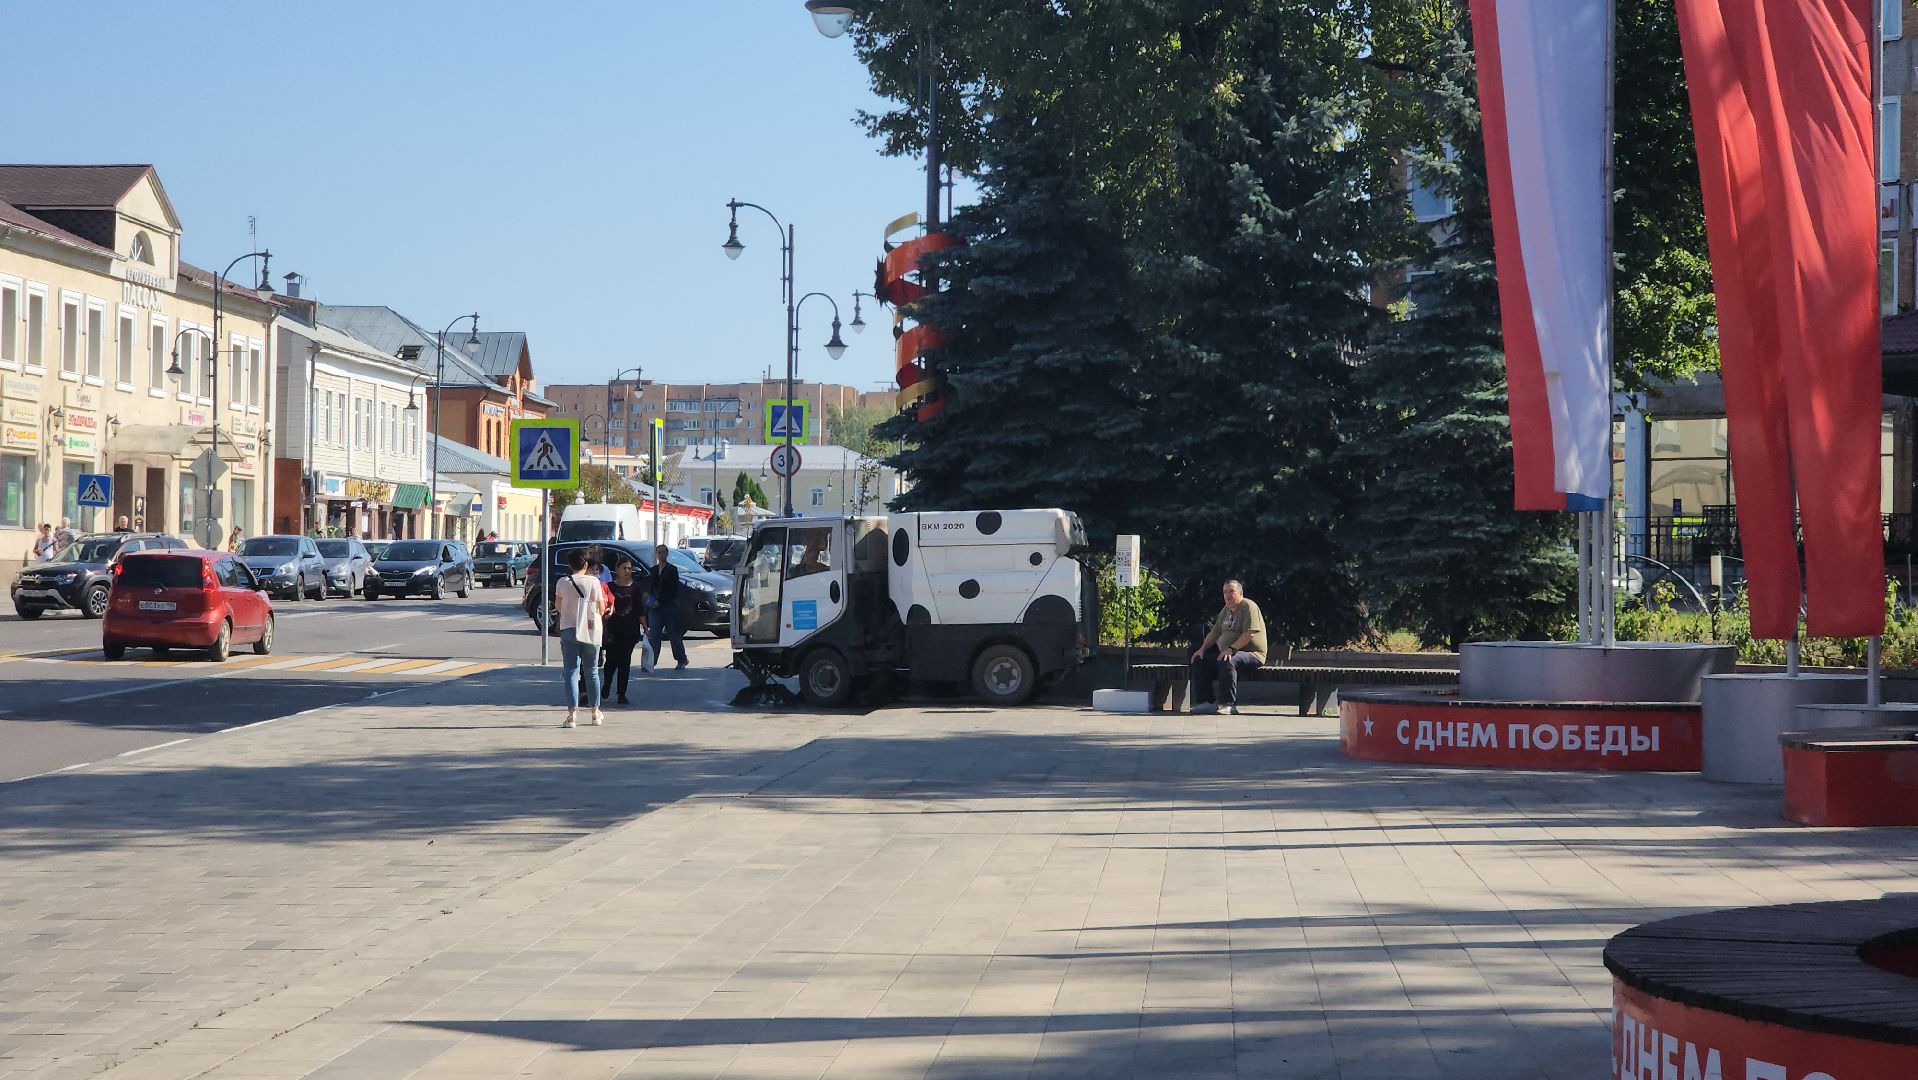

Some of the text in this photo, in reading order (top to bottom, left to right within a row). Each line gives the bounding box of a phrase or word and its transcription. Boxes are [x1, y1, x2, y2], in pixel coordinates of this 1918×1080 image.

[1396, 719, 1660, 756] С ДНЕМ ПОБЕДЫ
